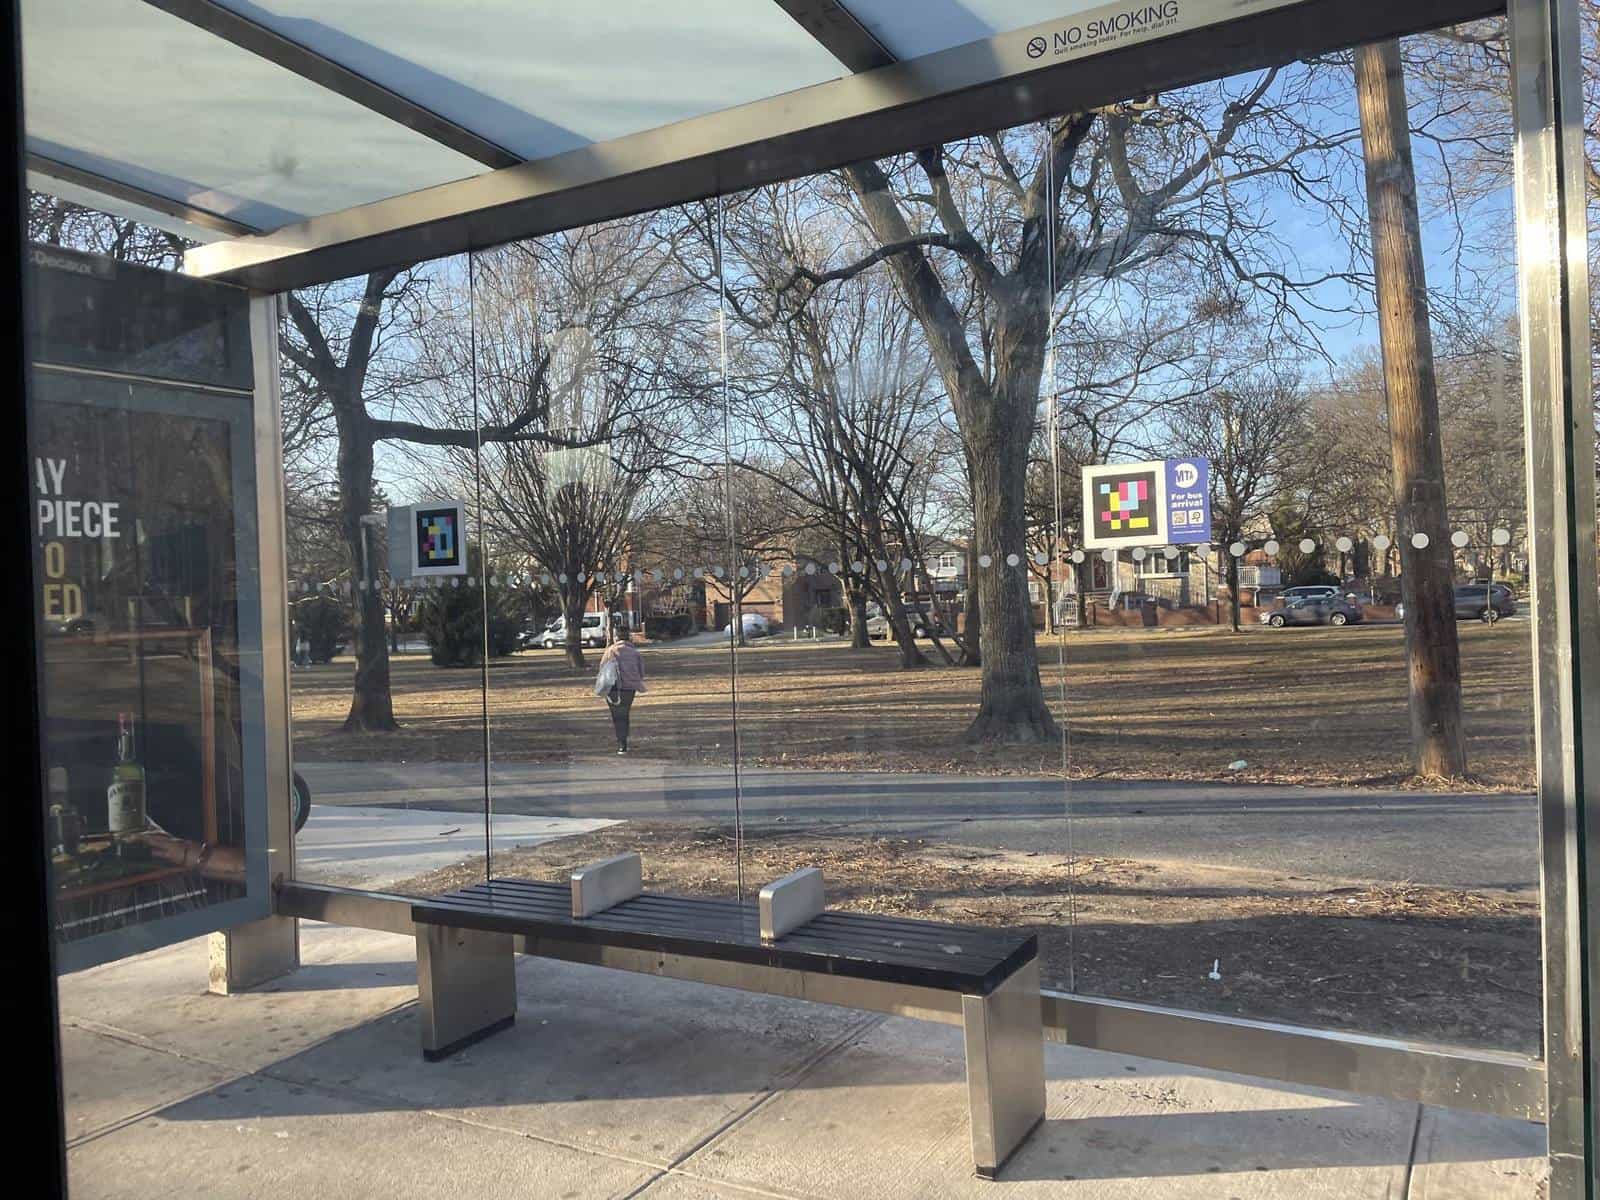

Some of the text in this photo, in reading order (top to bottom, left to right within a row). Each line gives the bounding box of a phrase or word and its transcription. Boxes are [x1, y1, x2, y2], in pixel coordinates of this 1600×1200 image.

[1053, 0, 1179, 49] NO SMOKING
[1171, 492, 1203, 501] For bus
[1171, 499, 1204, 508] arrival
[37, 499, 121, 538] PIECE
[43, 583, 83, 622] ED
